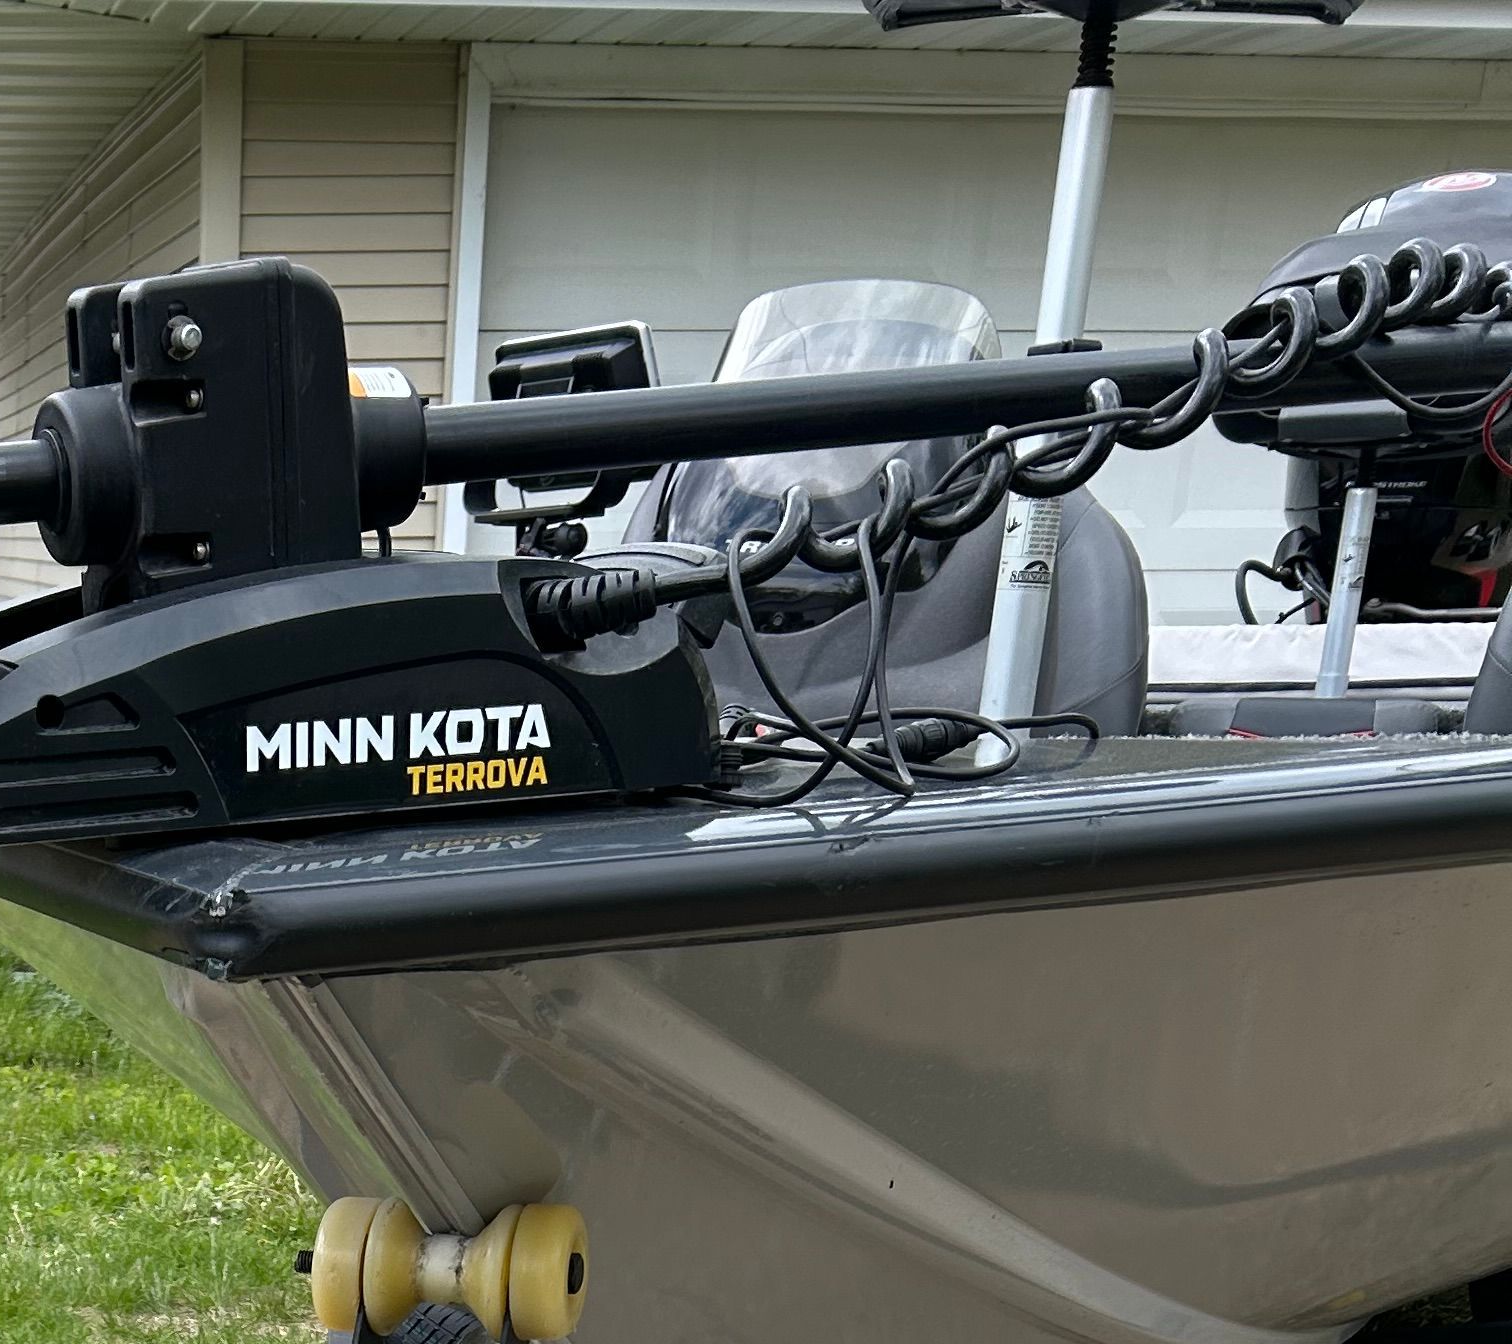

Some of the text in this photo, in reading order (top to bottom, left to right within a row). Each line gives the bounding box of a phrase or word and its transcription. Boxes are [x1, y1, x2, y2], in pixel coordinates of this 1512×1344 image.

[246, 703, 552, 773] MINN KOTA
[406, 755, 549, 796] TERROVA
